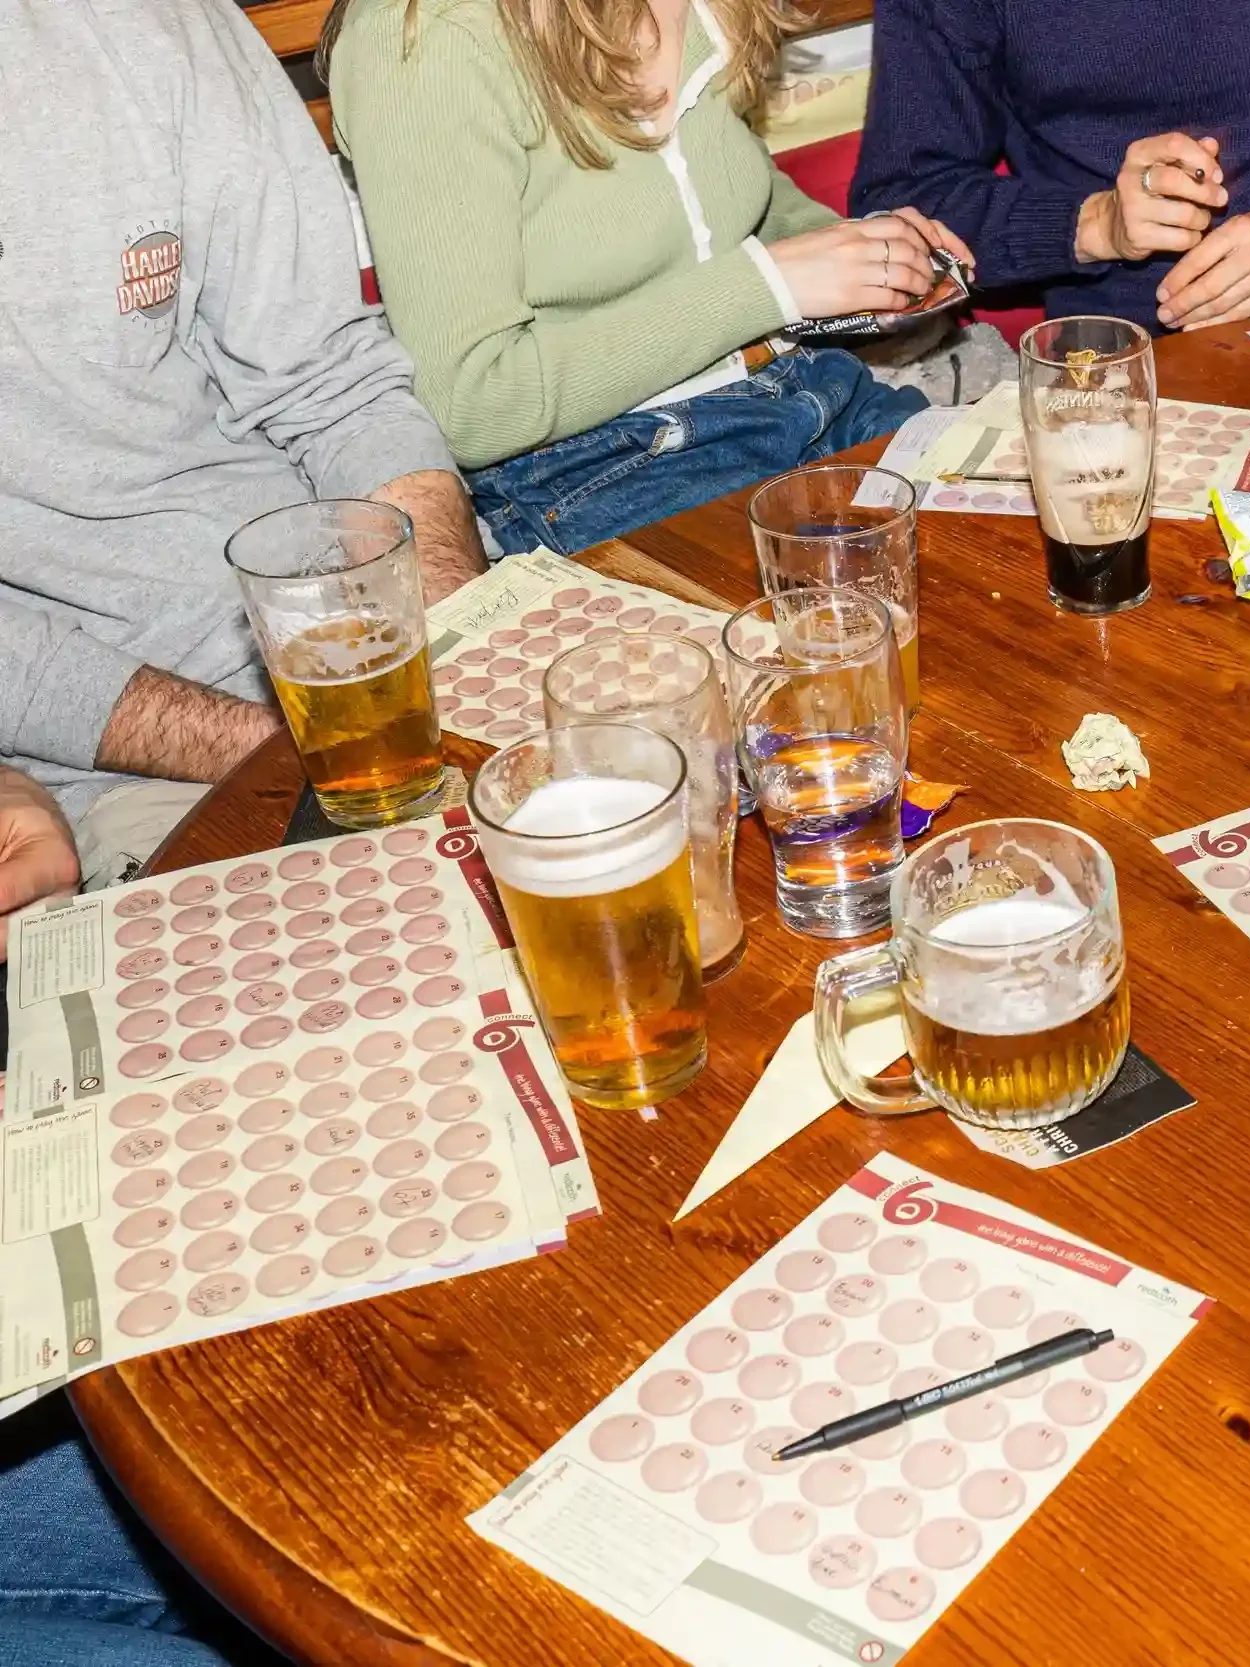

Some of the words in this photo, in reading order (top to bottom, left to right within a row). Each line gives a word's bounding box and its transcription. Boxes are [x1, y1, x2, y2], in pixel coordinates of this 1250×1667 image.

[121, 240, 181, 280] HARLE
[118, 267, 181, 313] DAVIDS
[487, 1013, 533, 1024] connect
